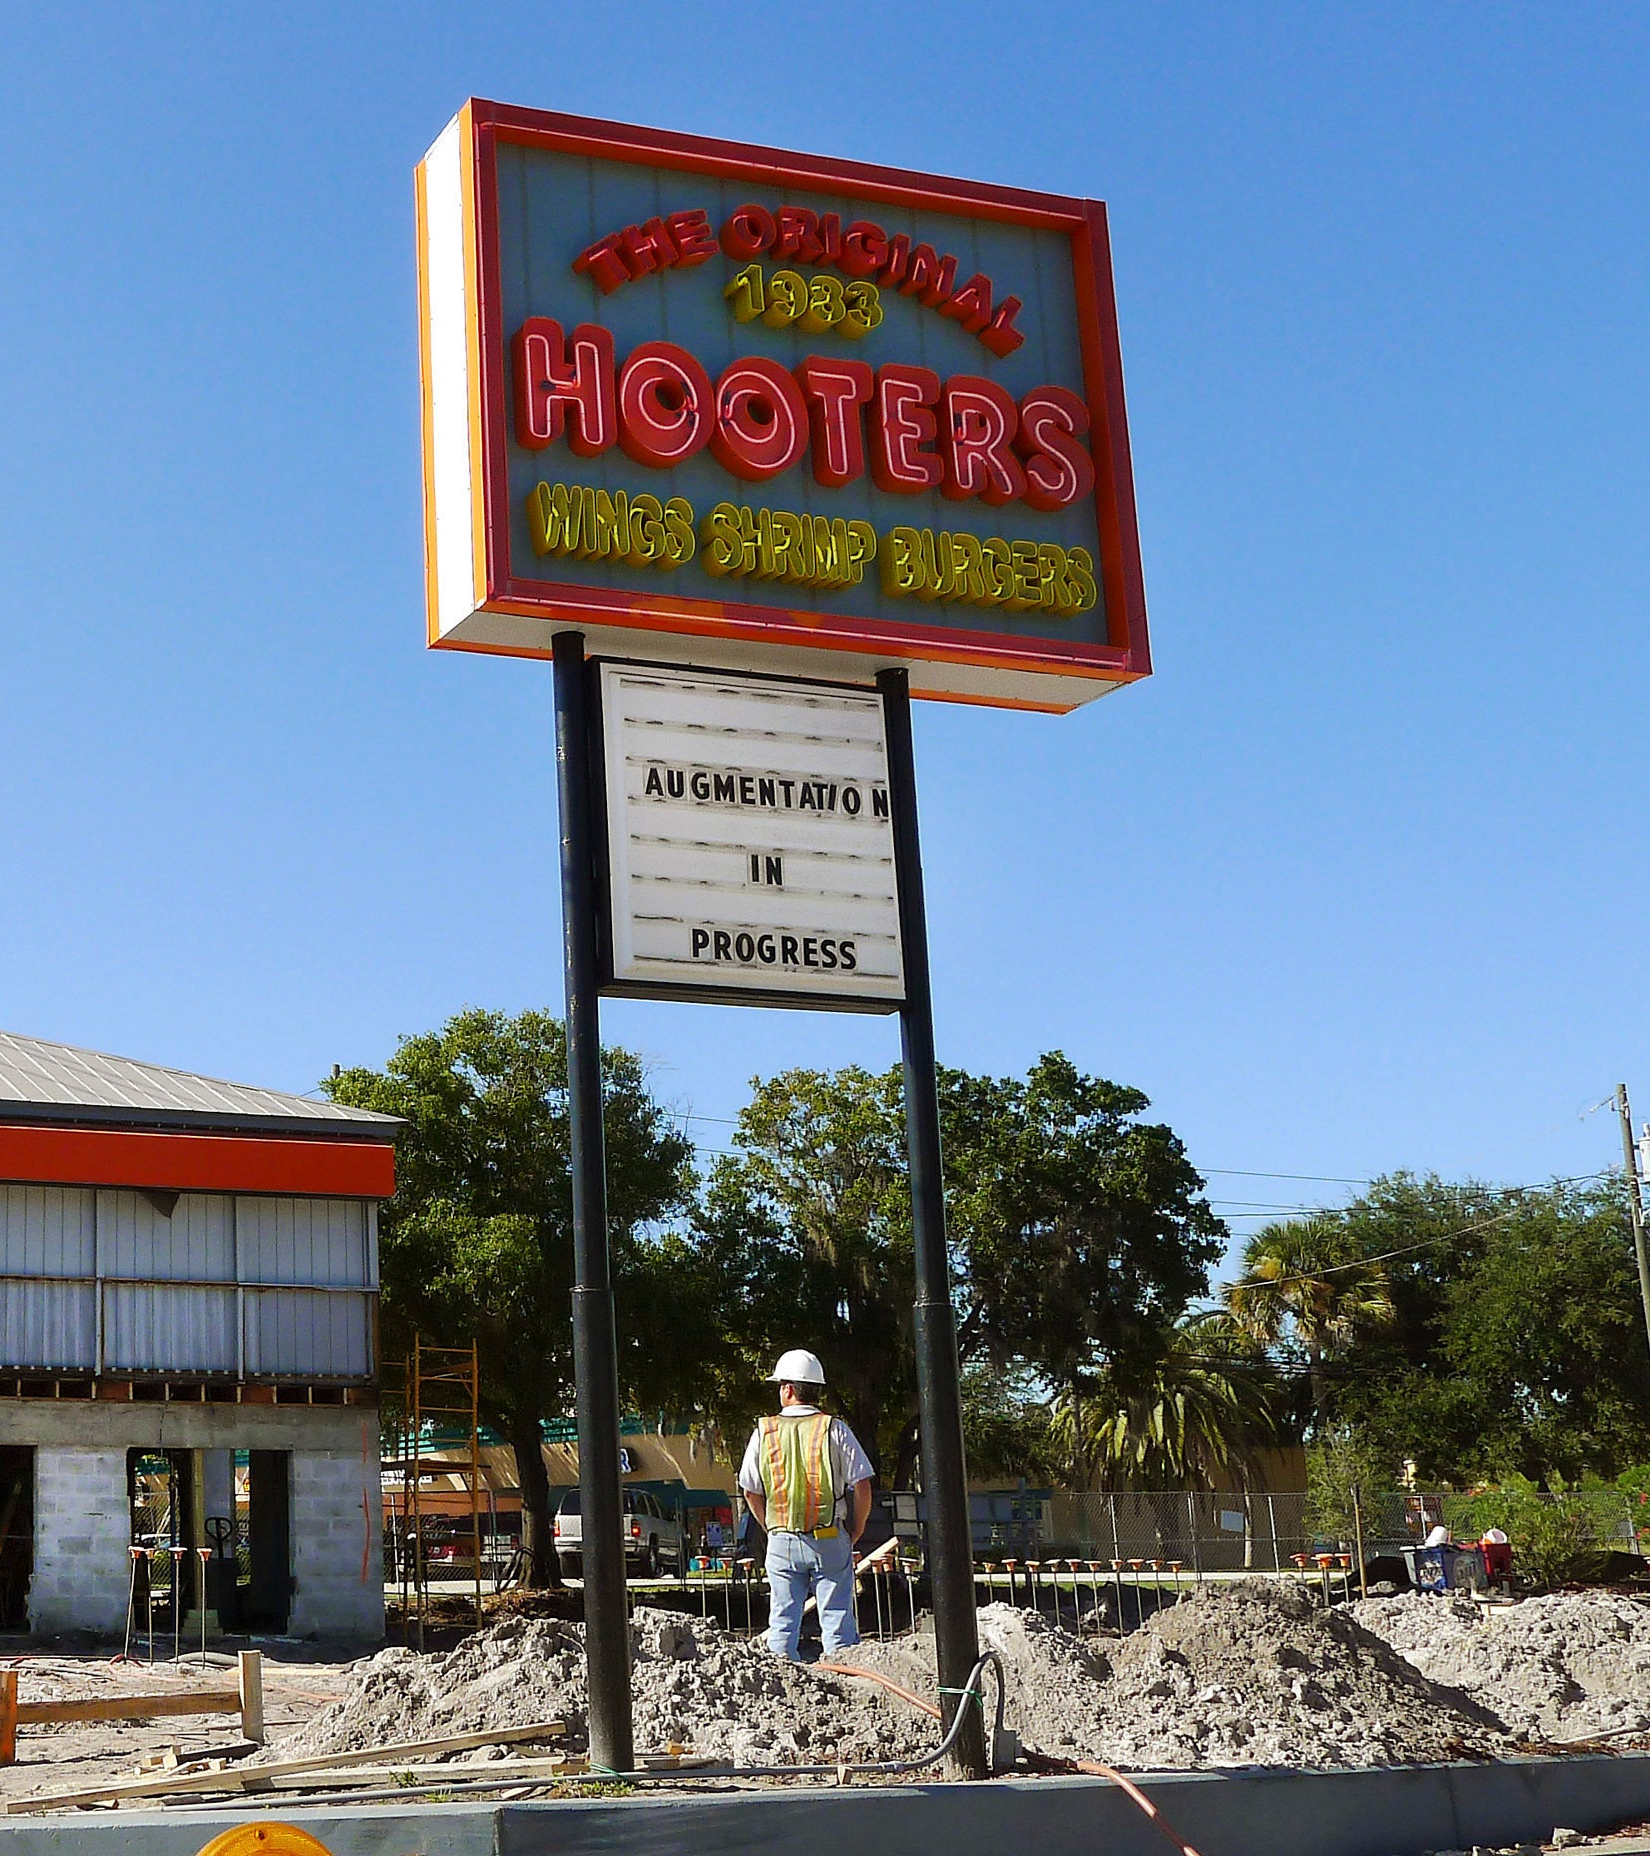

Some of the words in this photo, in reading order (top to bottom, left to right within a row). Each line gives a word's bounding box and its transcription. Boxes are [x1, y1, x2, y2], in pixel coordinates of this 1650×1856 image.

[572, 208, 720, 296] THE
[721, 204, 1025, 358] ORIGINAL
[724, 264, 883, 340] 1983
[512, 317, 1095, 511] HOOTERS
[528, 481, 695, 571] WINGS
[701, 502, 877, 590] SHRIMP
[881, 527, 1098, 618] BURGERS
[645, 767, 889, 817] AUGMENTATION
[751, 854, 783, 885] IN
[691, 928, 857, 970] PROGRESS
